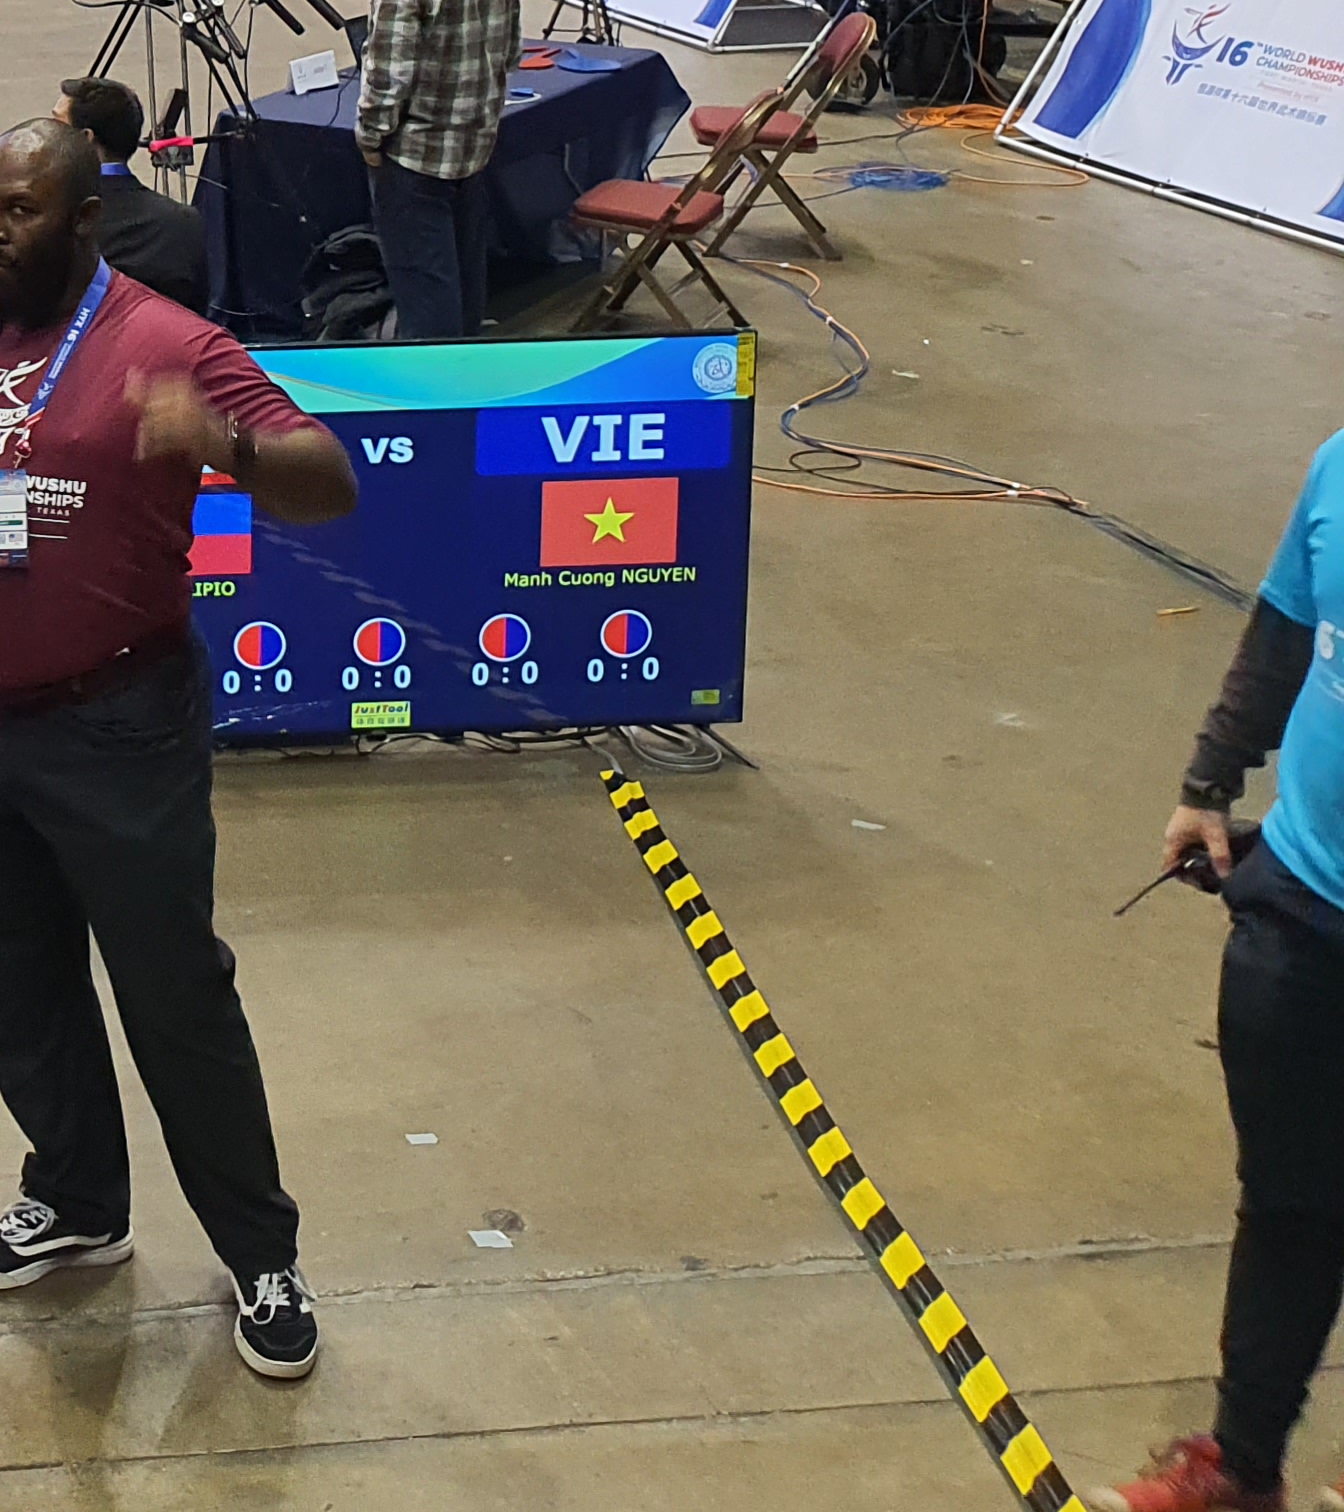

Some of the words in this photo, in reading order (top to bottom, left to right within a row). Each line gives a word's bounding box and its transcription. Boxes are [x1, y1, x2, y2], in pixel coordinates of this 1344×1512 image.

[1215, 37, 1255, 67] 16
[1262, 43, 1307, 64] WORLD
[540, 412, 666, 464] VIE
[36, 506, 71, 517] TEXAS
[504, 571, 553, 588] Manh
[557, 569, 616, 588] Cuong
[621, 566, 697, 585] NGUYEN
